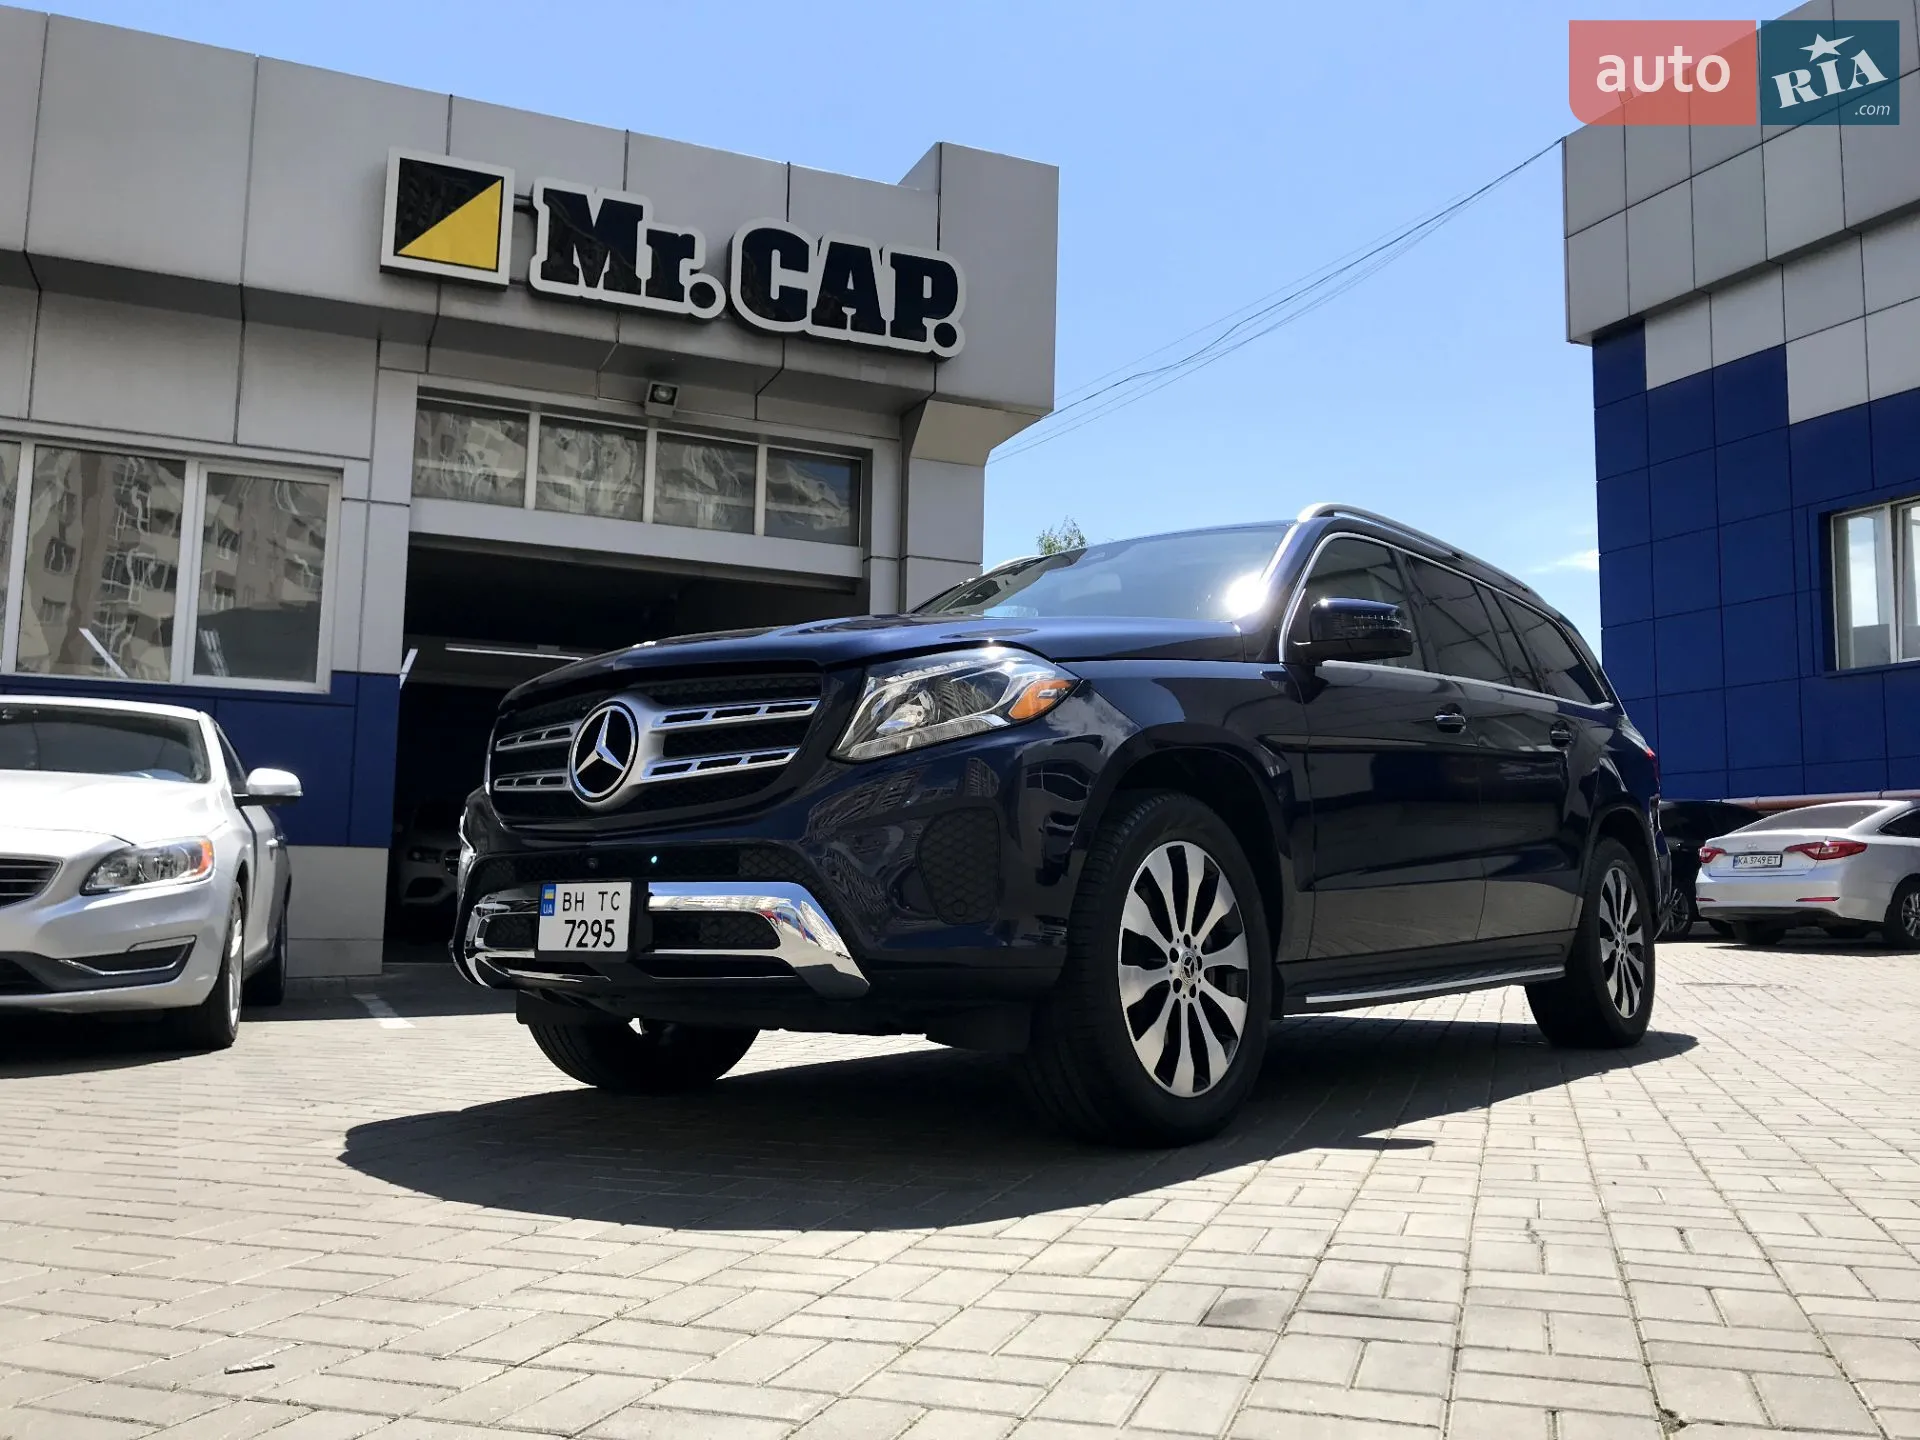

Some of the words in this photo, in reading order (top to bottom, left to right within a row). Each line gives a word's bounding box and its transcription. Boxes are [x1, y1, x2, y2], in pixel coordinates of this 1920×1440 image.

[538, 185, 719, 313] Mr.
[739, 225, 960, 350] CAP.
[543, 903, 554, 914] UA
[562, 891, 585, 912] BH
[598, 891, 621, 912] TC
[564, 919, 616, 949] 7295
